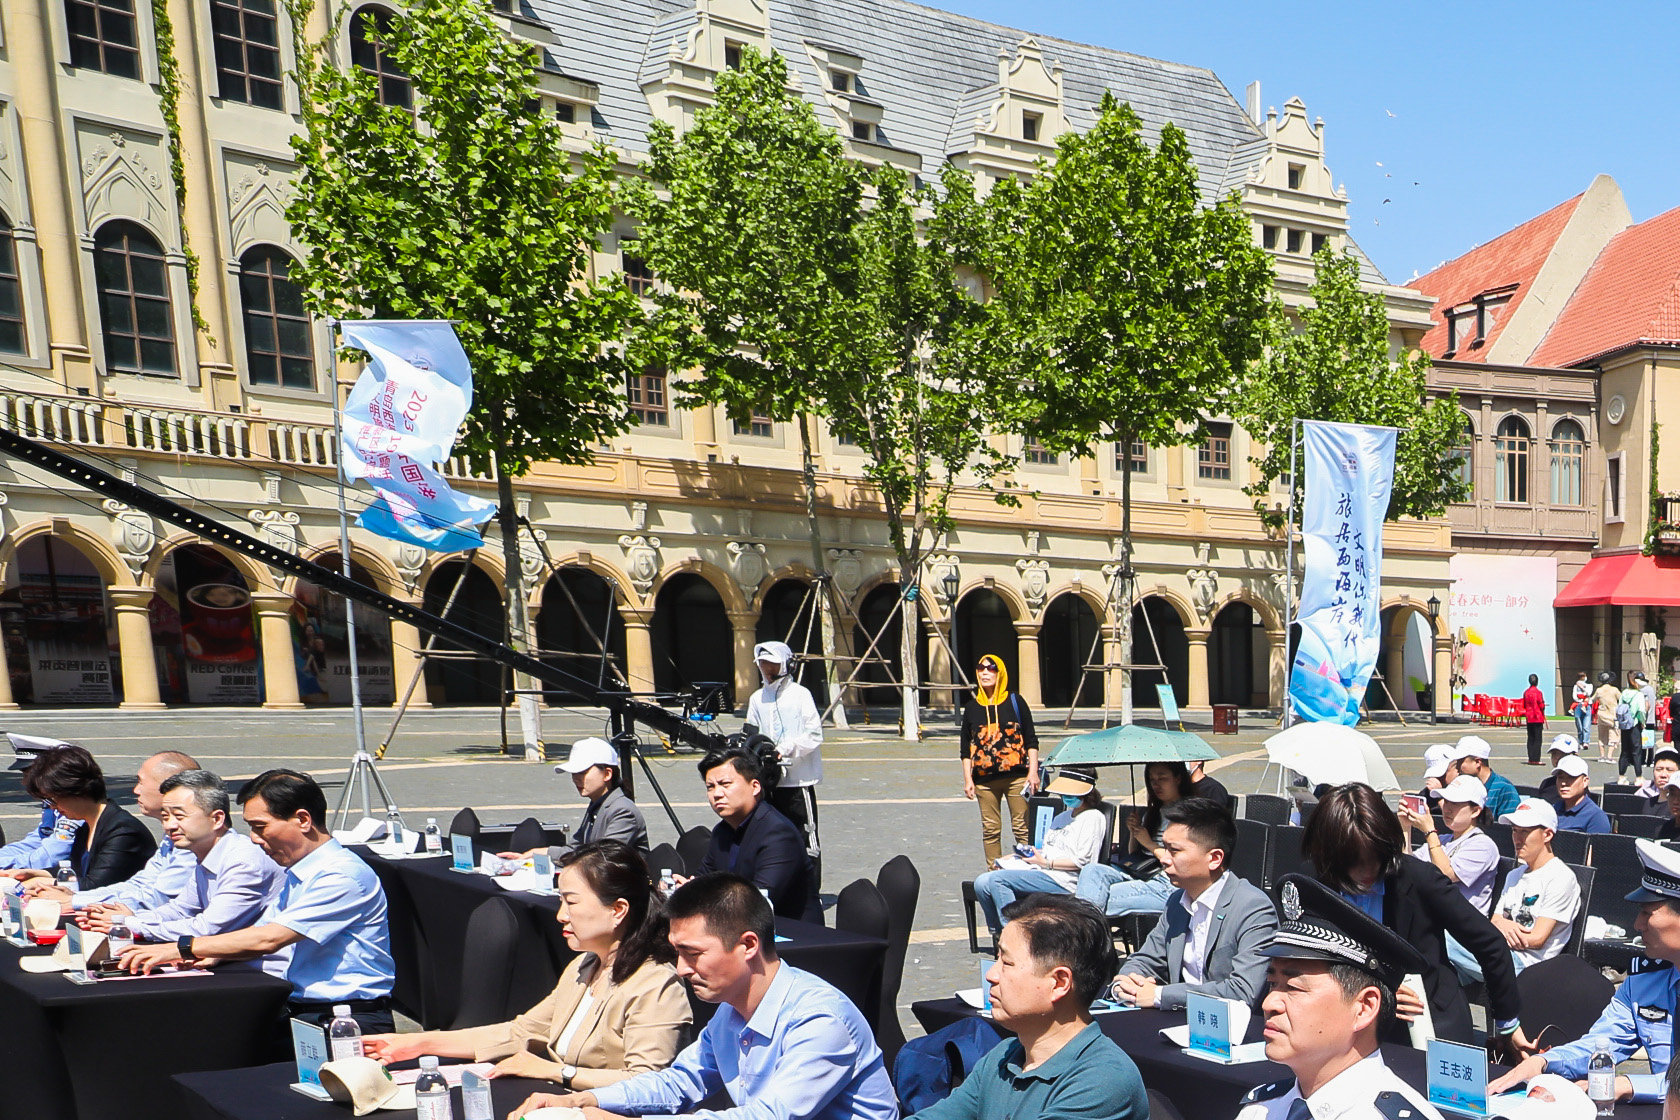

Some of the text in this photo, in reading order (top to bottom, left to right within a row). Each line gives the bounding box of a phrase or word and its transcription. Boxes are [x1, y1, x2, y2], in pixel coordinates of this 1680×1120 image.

[1331, 492, 1352, 623] 旅居西海岸
[190, 664, 255, 674] RED Coffee
[1197, 1010, 1219, 1029] 韩晓
[1439, 1059, 1473, 1082] 王志波
